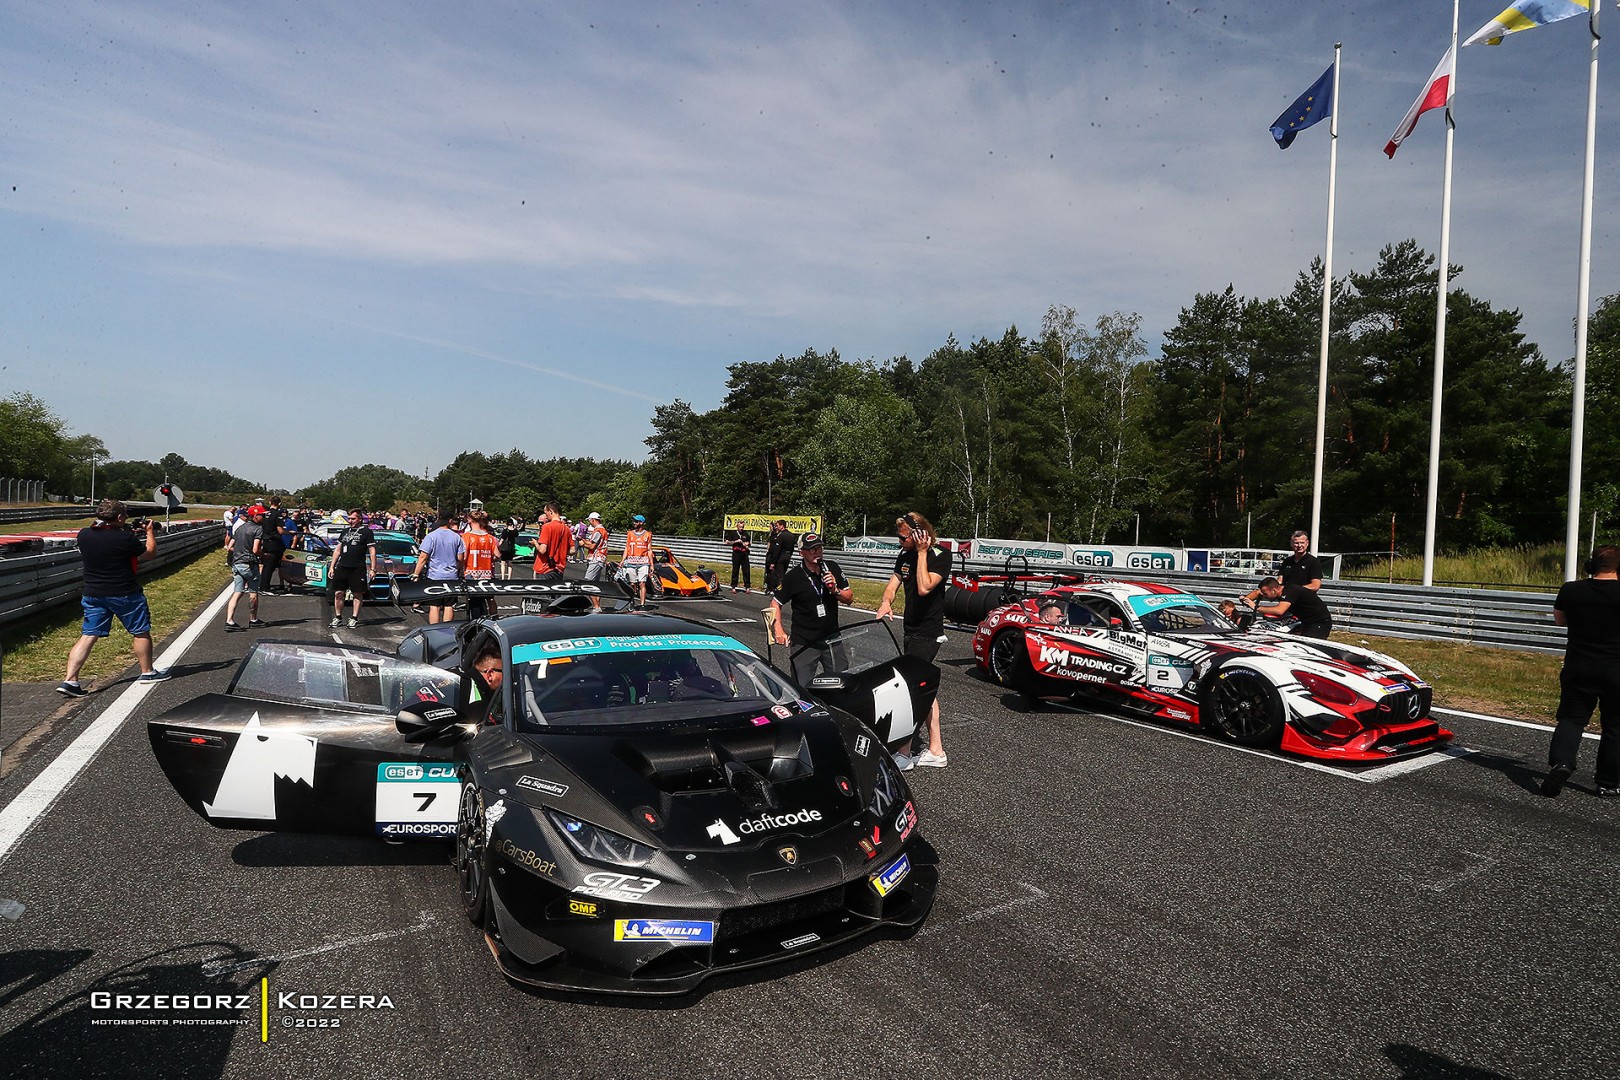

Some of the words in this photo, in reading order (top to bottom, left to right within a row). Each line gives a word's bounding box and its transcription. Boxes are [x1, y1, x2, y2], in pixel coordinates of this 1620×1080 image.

[470, 550, 479, 567] T
[978, 545, 1003, 555] ESET
[1002, 547, 1025, 556] CUP
[1025, 548, 1064, 560] SERIES
[1076, 553, 1111, 566] eset
[1130, 553, 1172, 569] eset
[424, 581, 601, 595] daftcode
[543, 638, 598, 651] eset
[610, 640, 667, 648] Progress.
[668, 639, 728, 647] Protected.
[1110, 630, 1147, 650] BigMat
[1040, 646, 1069, 666] KM
[1070, 655, 1112, 671] TRADING
[1113, 664, 1127, 674] CZ
[529, 659, 548, 679] 7
[1057, 666, 1107, 684] kovoperner
[1157, 670, 1169, 680] 2
[387, 766, 422, 778] eset
[428, 767, 457, 778] CU
[413, 792, 437, 812] 7
[739, 808, 822, 834] daftcode
[895, 801, 915, 832] GT3
[386, 824, 458, 834] EUROSPOR
[583, 872, 661, 894] GT3
[571, 886, 646, 901] POLAND
[569, 902, 597, 914] OMP
[641, 924, 703, 936] MICHELIN
